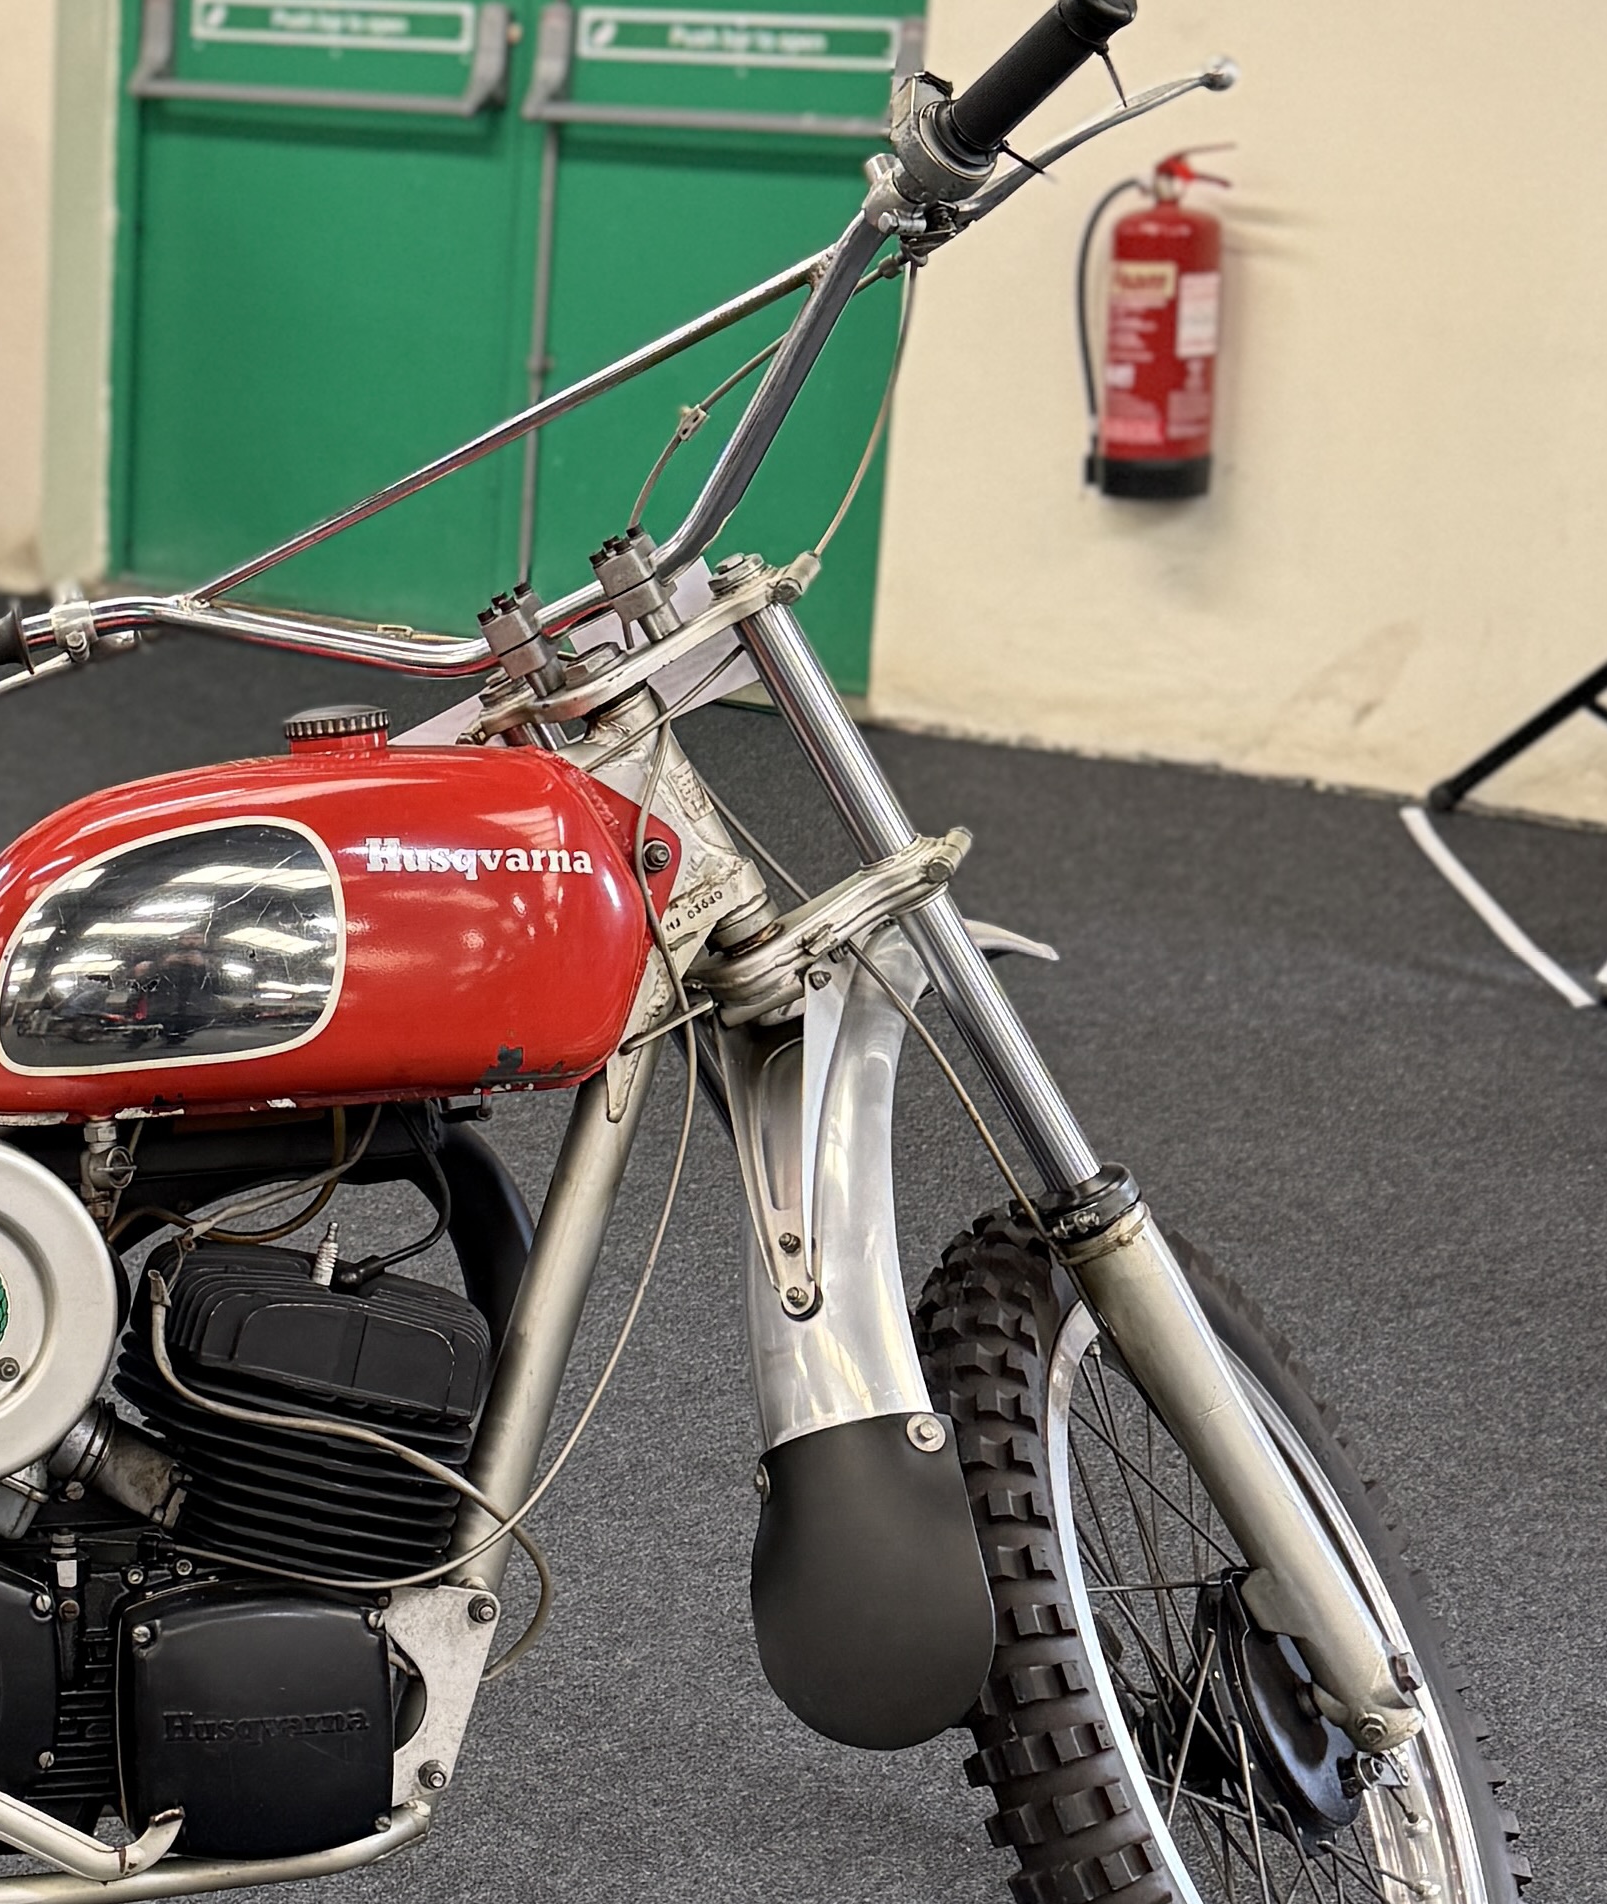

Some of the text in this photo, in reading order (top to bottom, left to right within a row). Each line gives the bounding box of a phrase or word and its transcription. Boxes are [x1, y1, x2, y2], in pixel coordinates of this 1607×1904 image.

[270, 7, 313, 30] Push
[368, 16, 410, 36] open
[668, 24, 717, 47] Push
[779, 32, 828, 54] open
[365, 838, 593, 880] Husqvarna
[162, 1709, 370, 1745] Husqvarna
